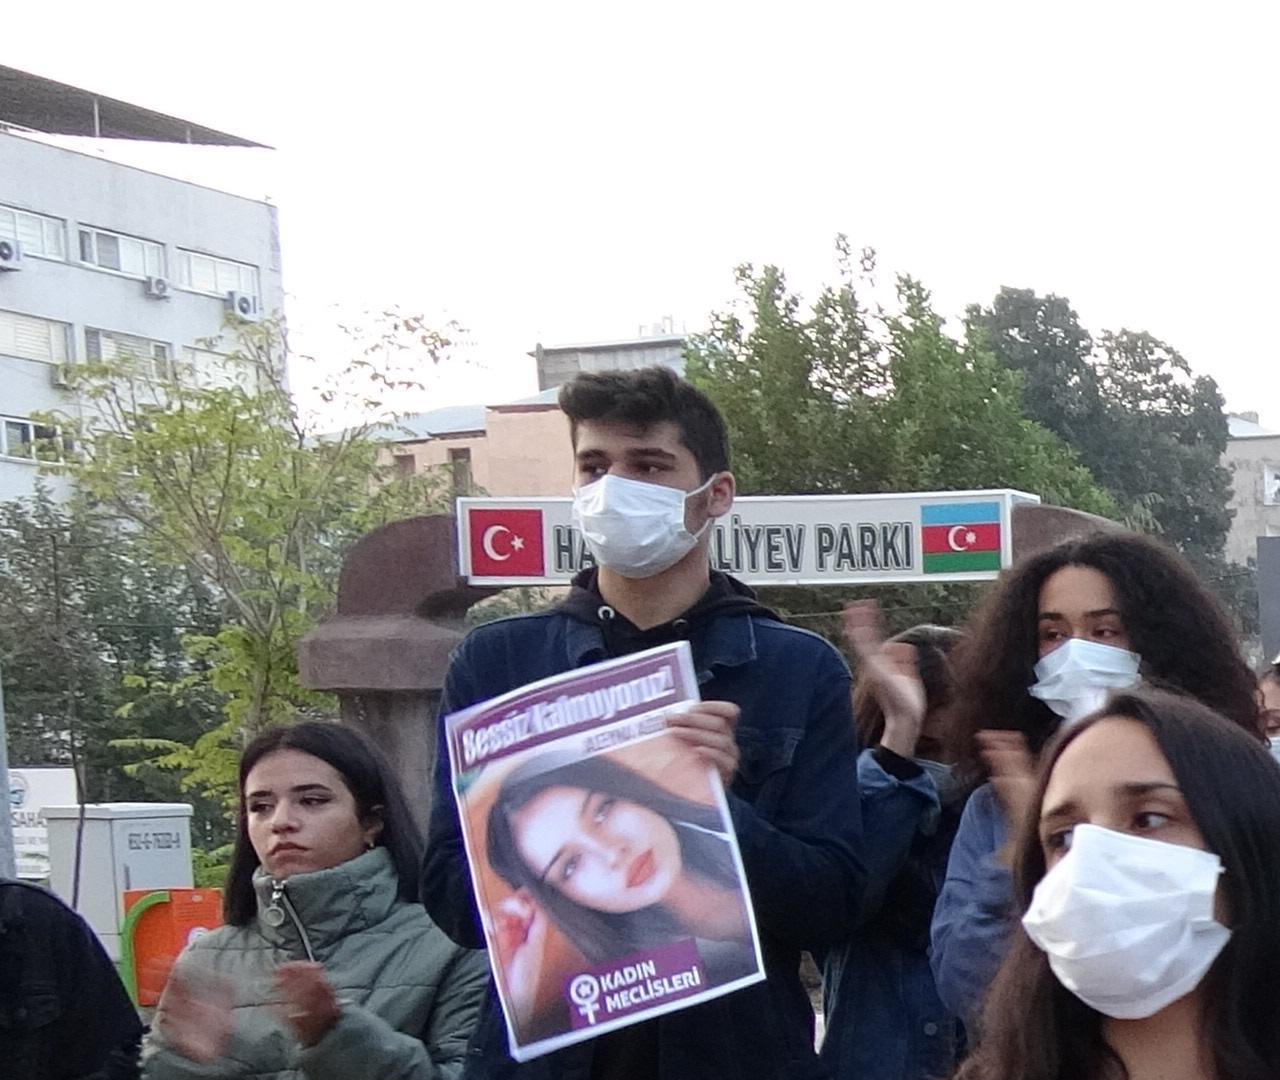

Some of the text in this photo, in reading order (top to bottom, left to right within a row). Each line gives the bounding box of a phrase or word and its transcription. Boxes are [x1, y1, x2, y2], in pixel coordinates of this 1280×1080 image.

[712, 514, 913, 573] LİYEV PARKI
[601, 959, 656, 992] KADIN
[605, 967, 700, 1014] MECLİSLERİ
